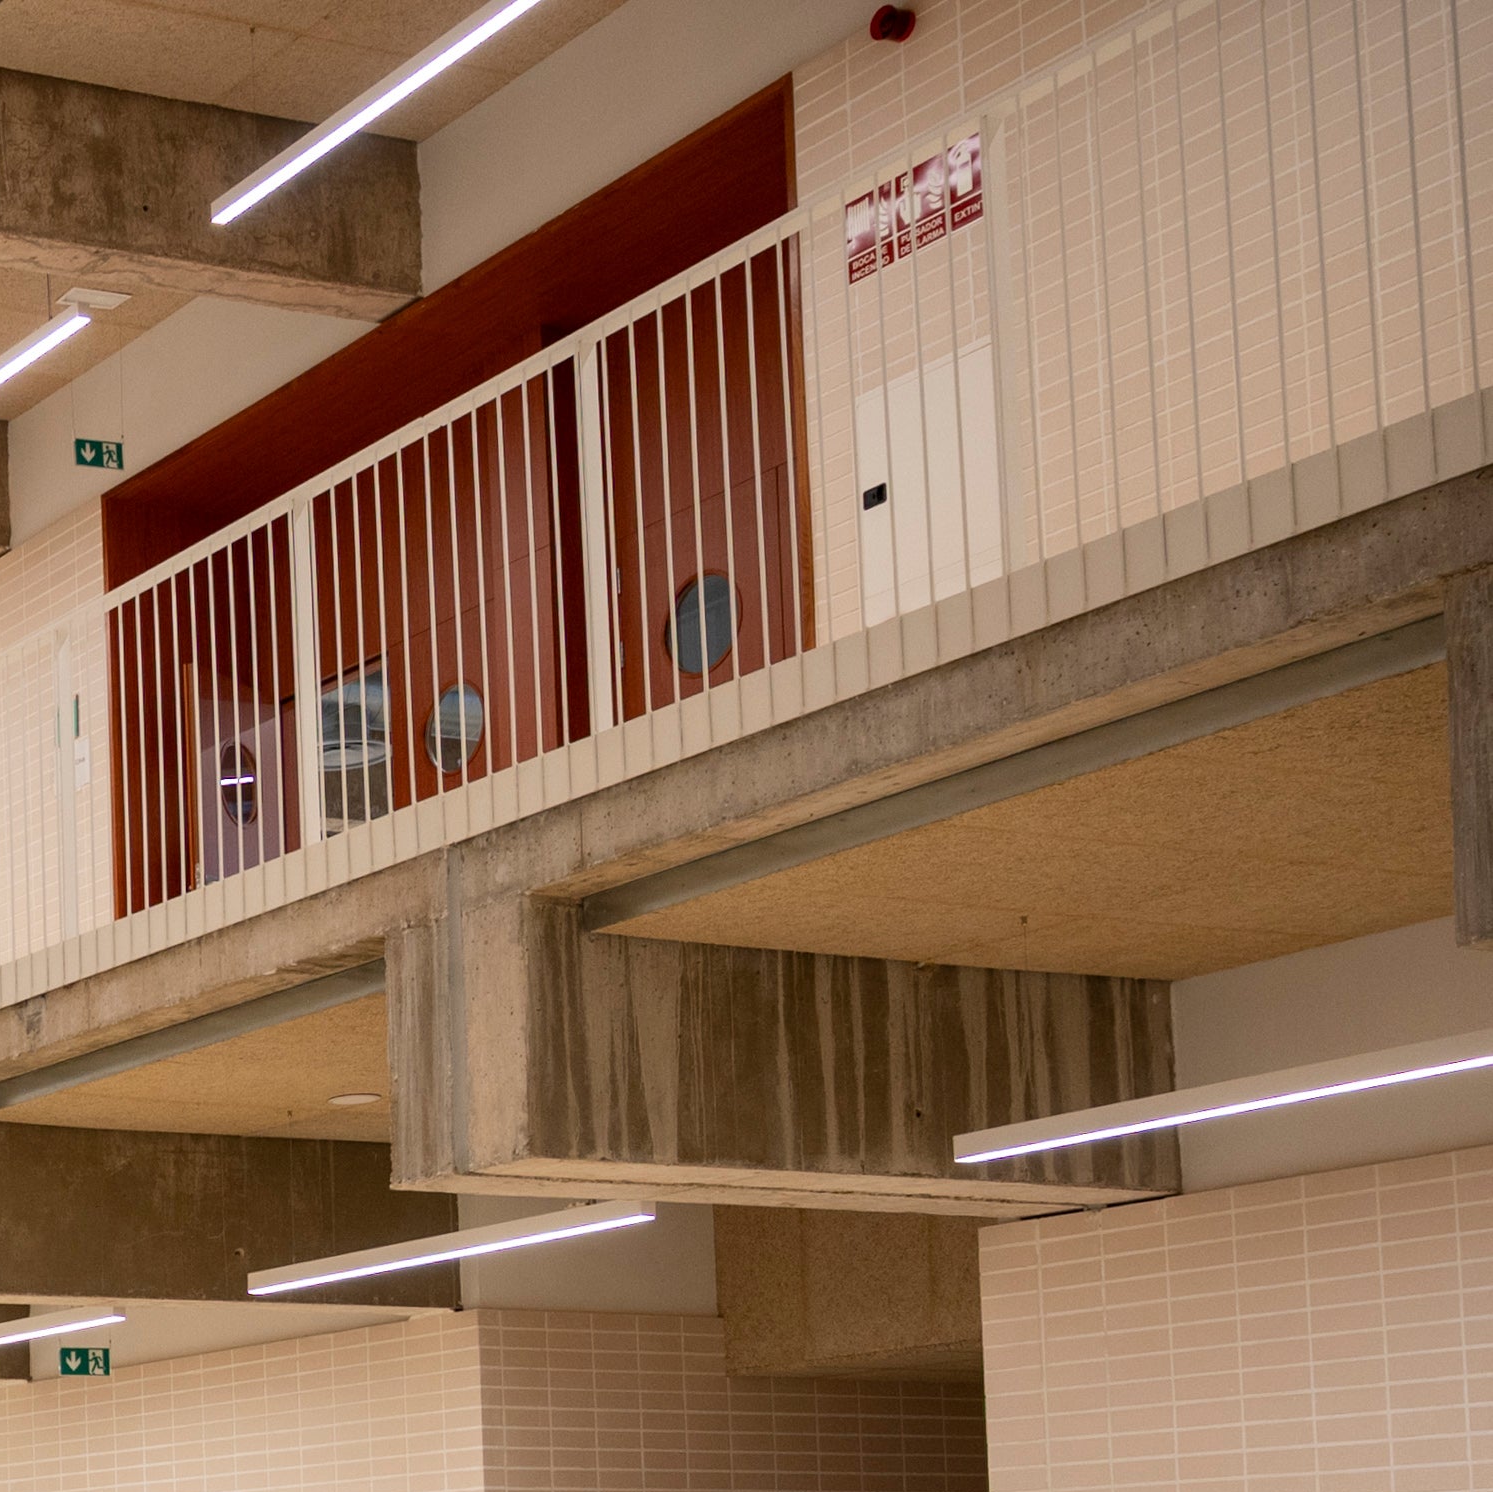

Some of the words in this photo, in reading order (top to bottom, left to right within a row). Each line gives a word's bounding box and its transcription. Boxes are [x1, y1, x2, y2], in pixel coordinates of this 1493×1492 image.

[900, 215, 943, 244] PUSADOR
[916, 227, 945, 247] LARMA
[851, 252, 876, 270] BOCA
